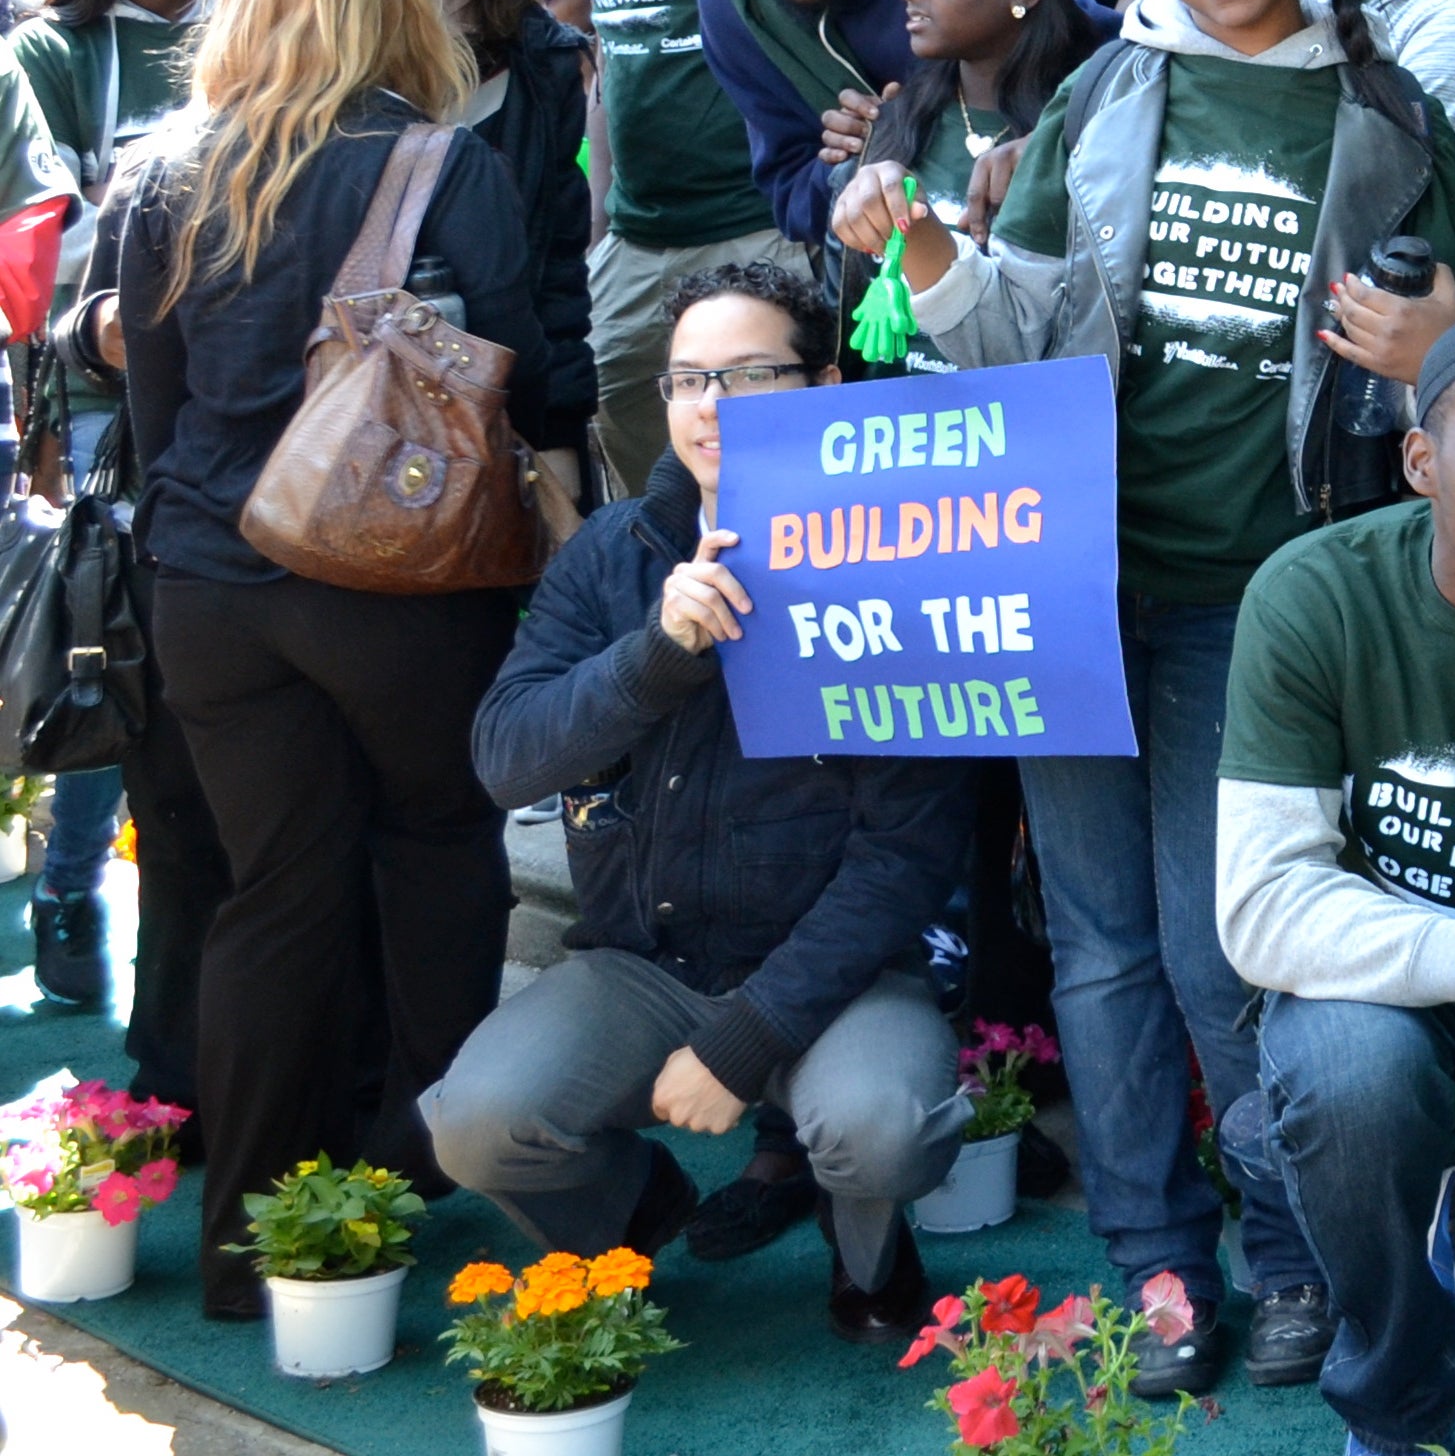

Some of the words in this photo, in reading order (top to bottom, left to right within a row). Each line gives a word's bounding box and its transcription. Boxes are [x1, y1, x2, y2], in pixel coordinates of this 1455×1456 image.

[1152, 191, 1299, 235] UILDING
[1150, 220, 1191, 243] UR
[1196, 236, 1313, 276] FUTUR
[1146, 262, 1302, 308] GETHER
[820, 401, 1006, 475] GREEN
[769, 487, 1043, 570] BUILDING
[788, 598, 903, 662] FOR
[921, 593, 1034, 654] THE
[820, 677, 1045, 742] FUTURE
[1379, 815, 1444, 853] OUR
